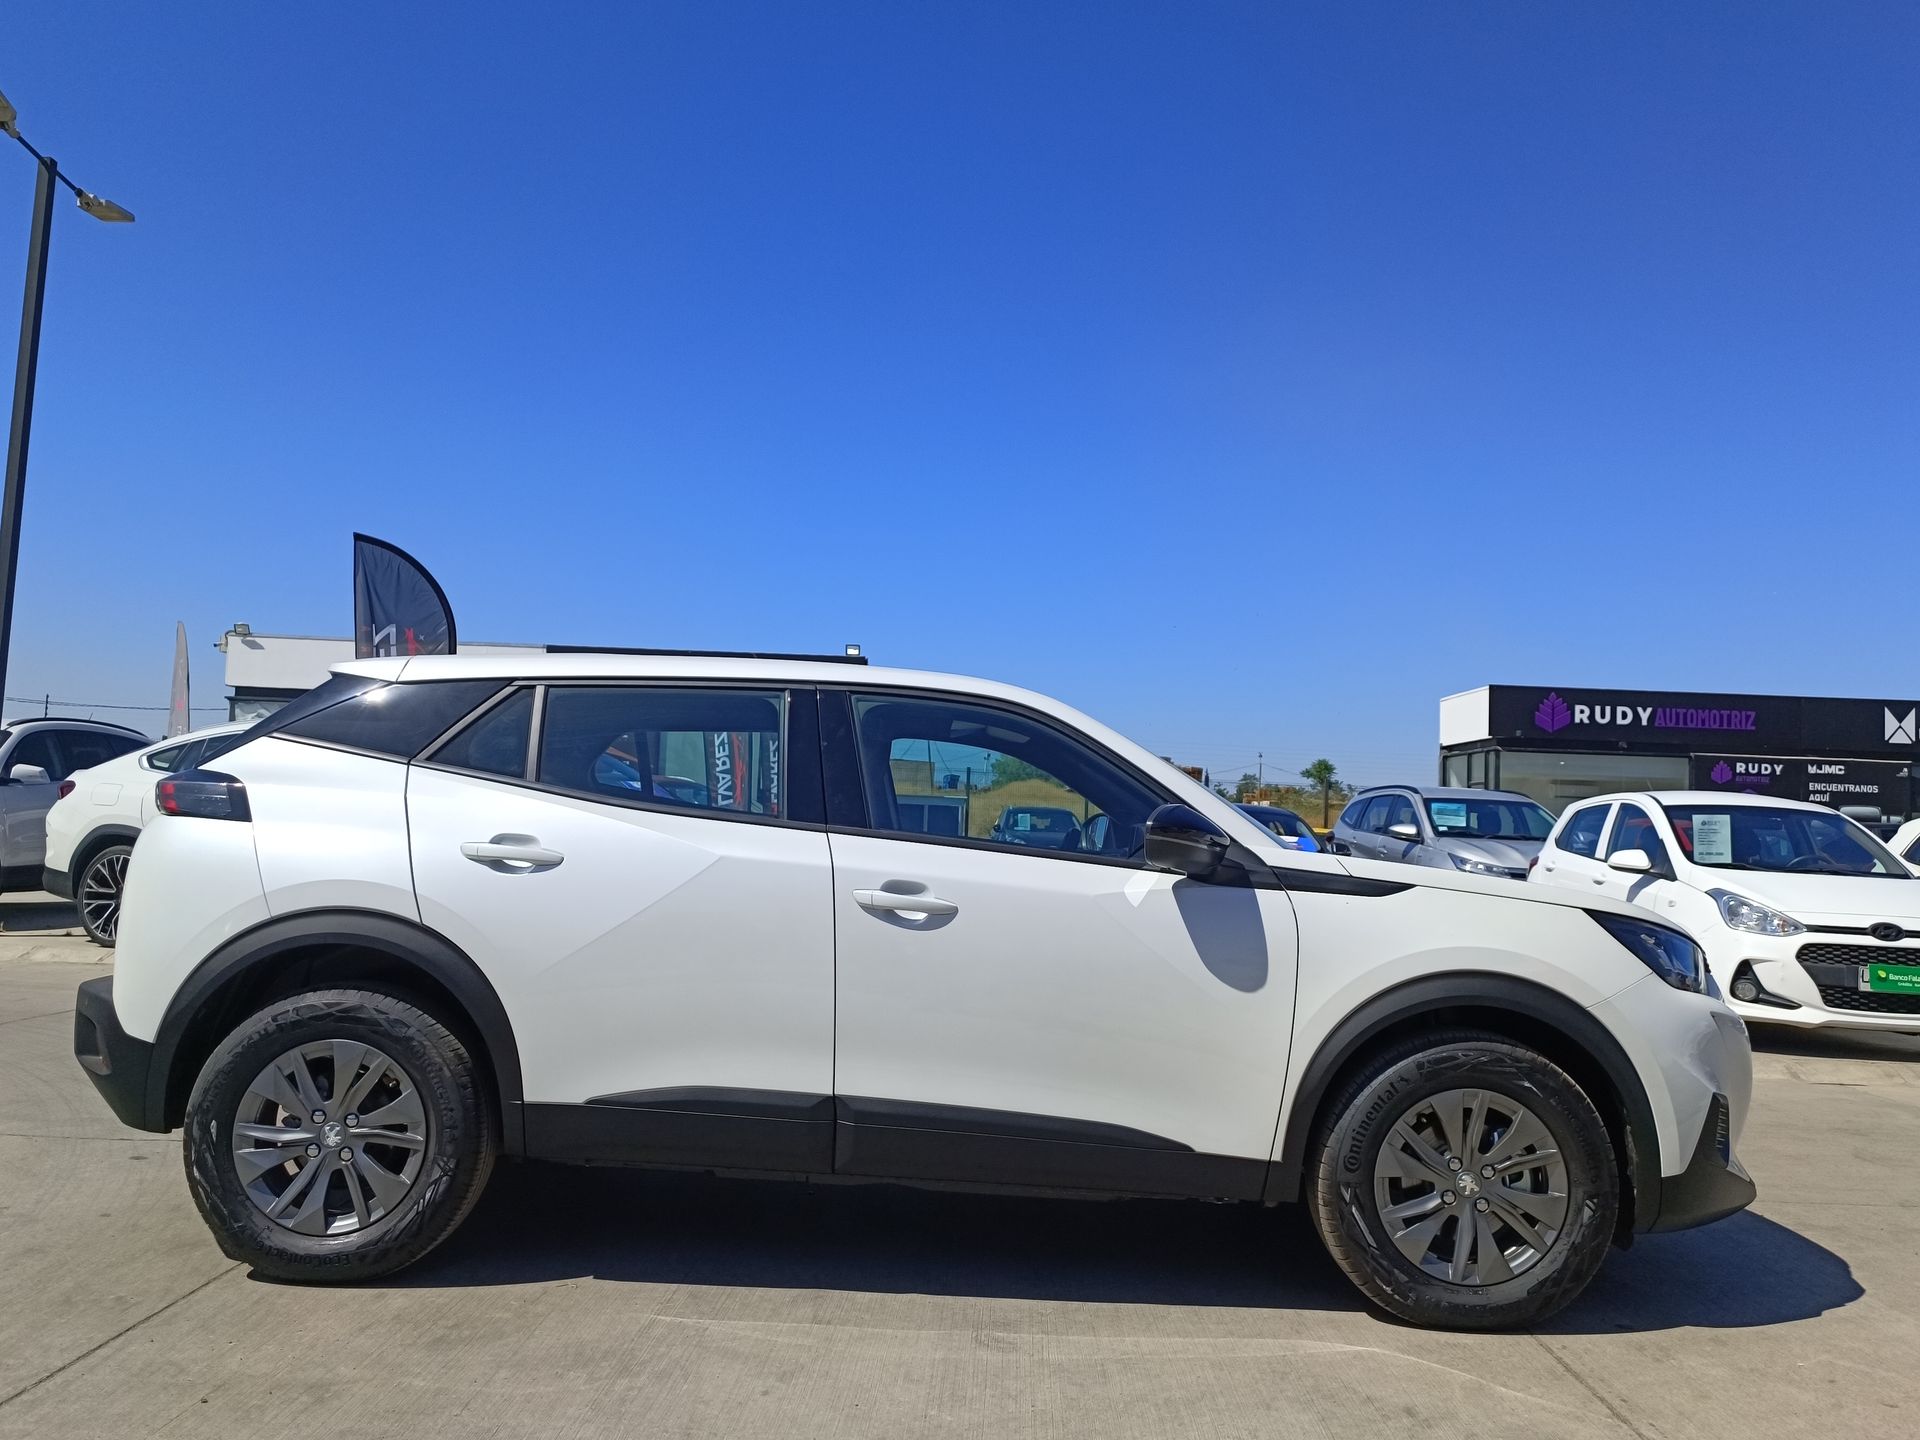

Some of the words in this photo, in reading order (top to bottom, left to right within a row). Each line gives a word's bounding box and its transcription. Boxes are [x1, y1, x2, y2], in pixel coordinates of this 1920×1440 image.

[1574, 704, 1653, 726] RUDY
[1655, 707, 1756, 730] AUTOMOTRIZ
[1736, 763, 1784, 775] RUDY
[1808, 783, 1879, 793] ENCUENTRANOS
[1889, 973, 1908, 981] Banco
[1343, 1082, 1401, 1173] Continental
